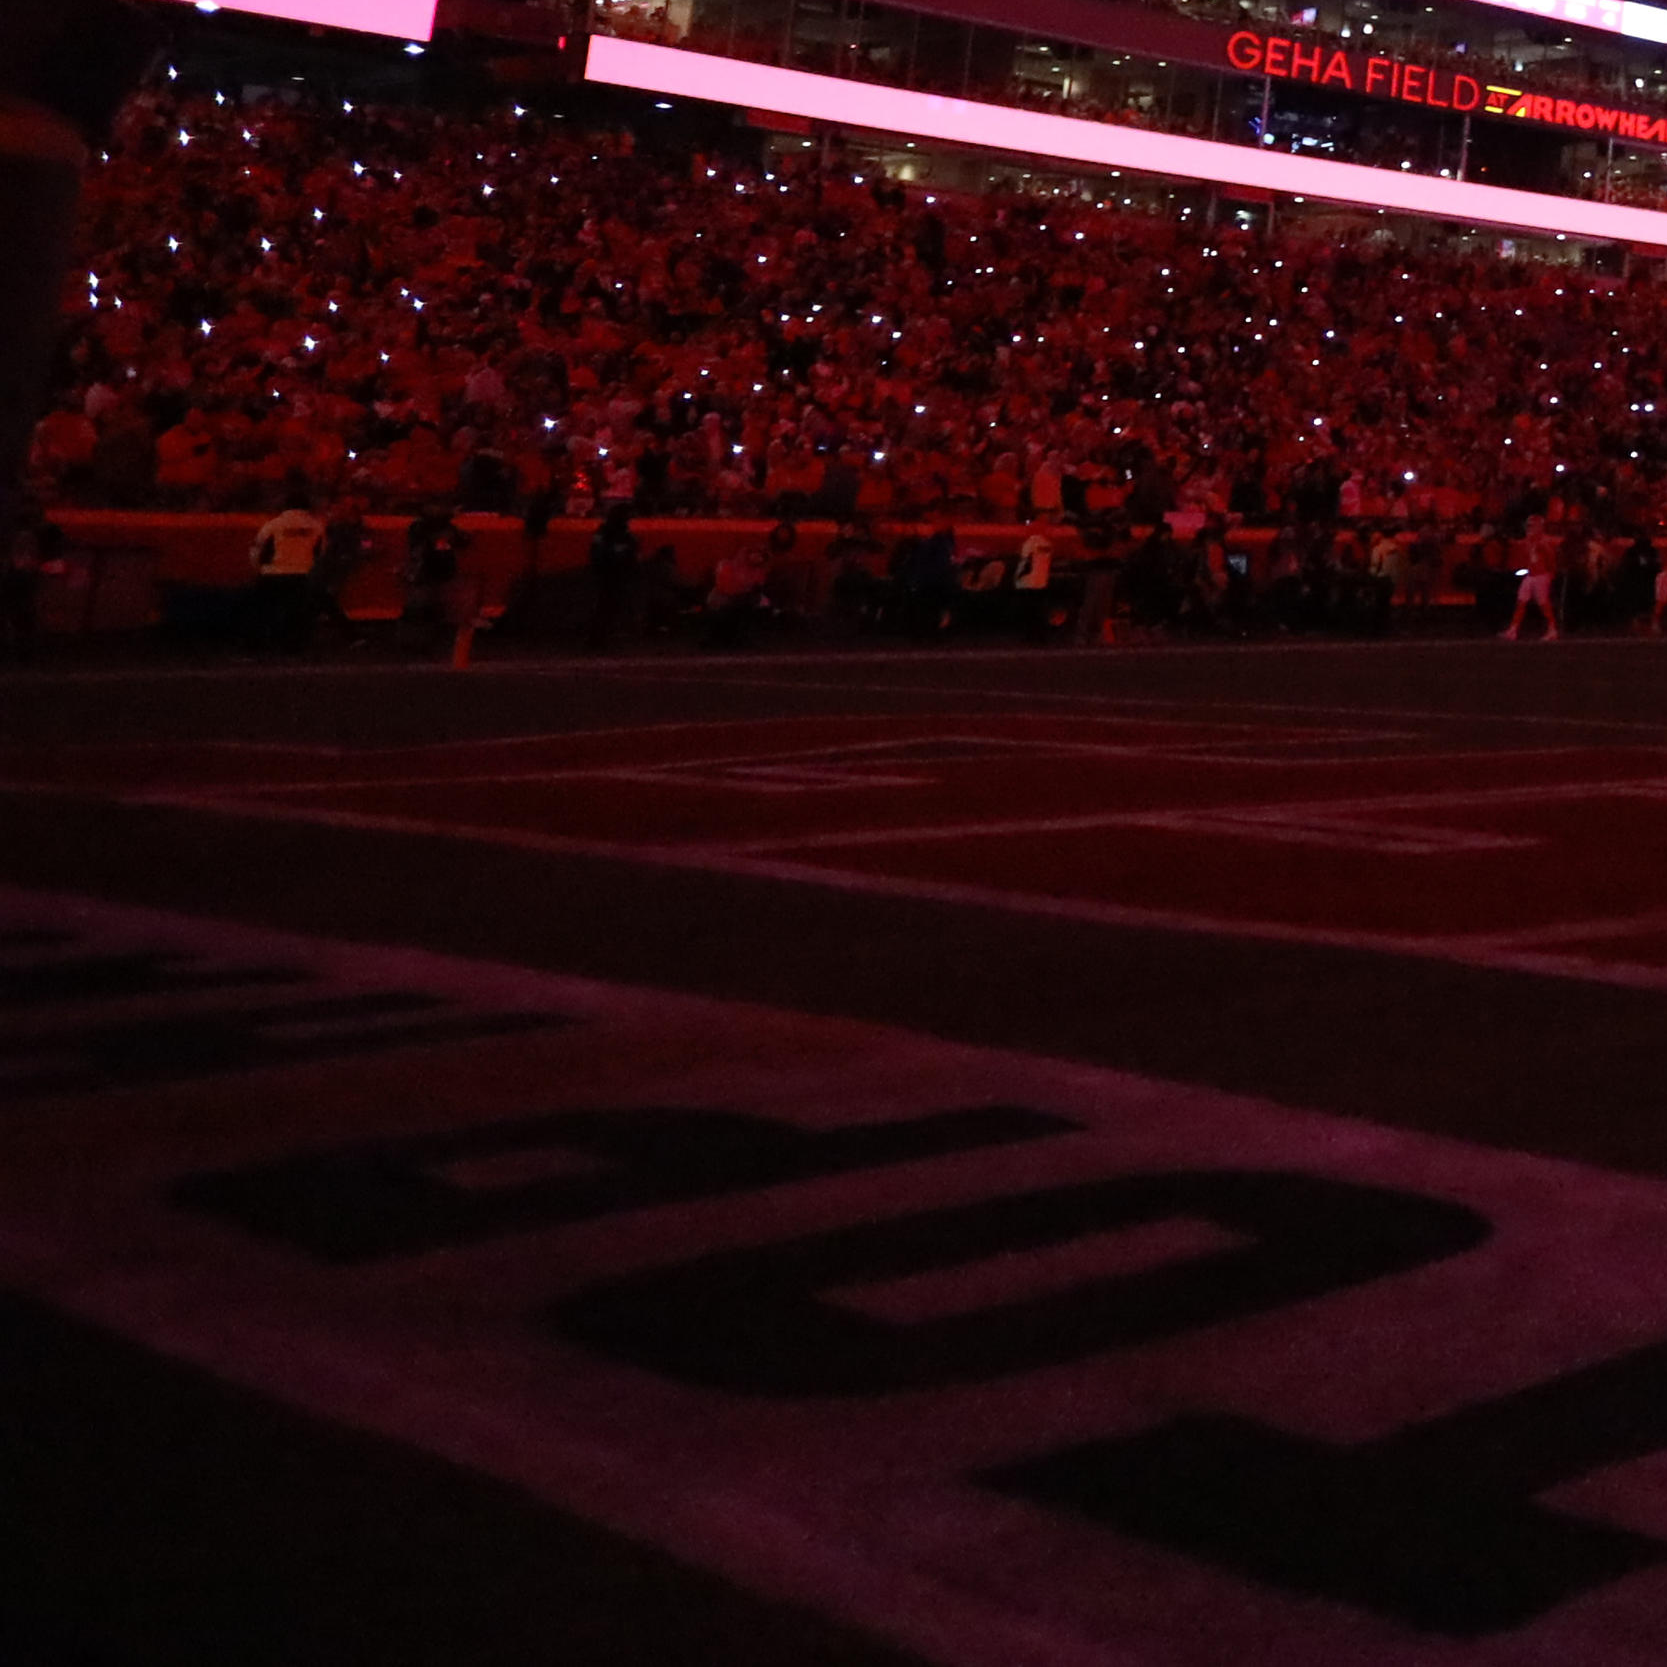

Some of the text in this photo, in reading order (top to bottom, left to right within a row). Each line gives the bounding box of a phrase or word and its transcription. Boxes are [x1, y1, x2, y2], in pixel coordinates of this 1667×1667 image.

[1226, 30, 1352, 90] GEHA
[1365, 57, 1480, 111] FIELD
[1486, 91, 1507, 109] AT
